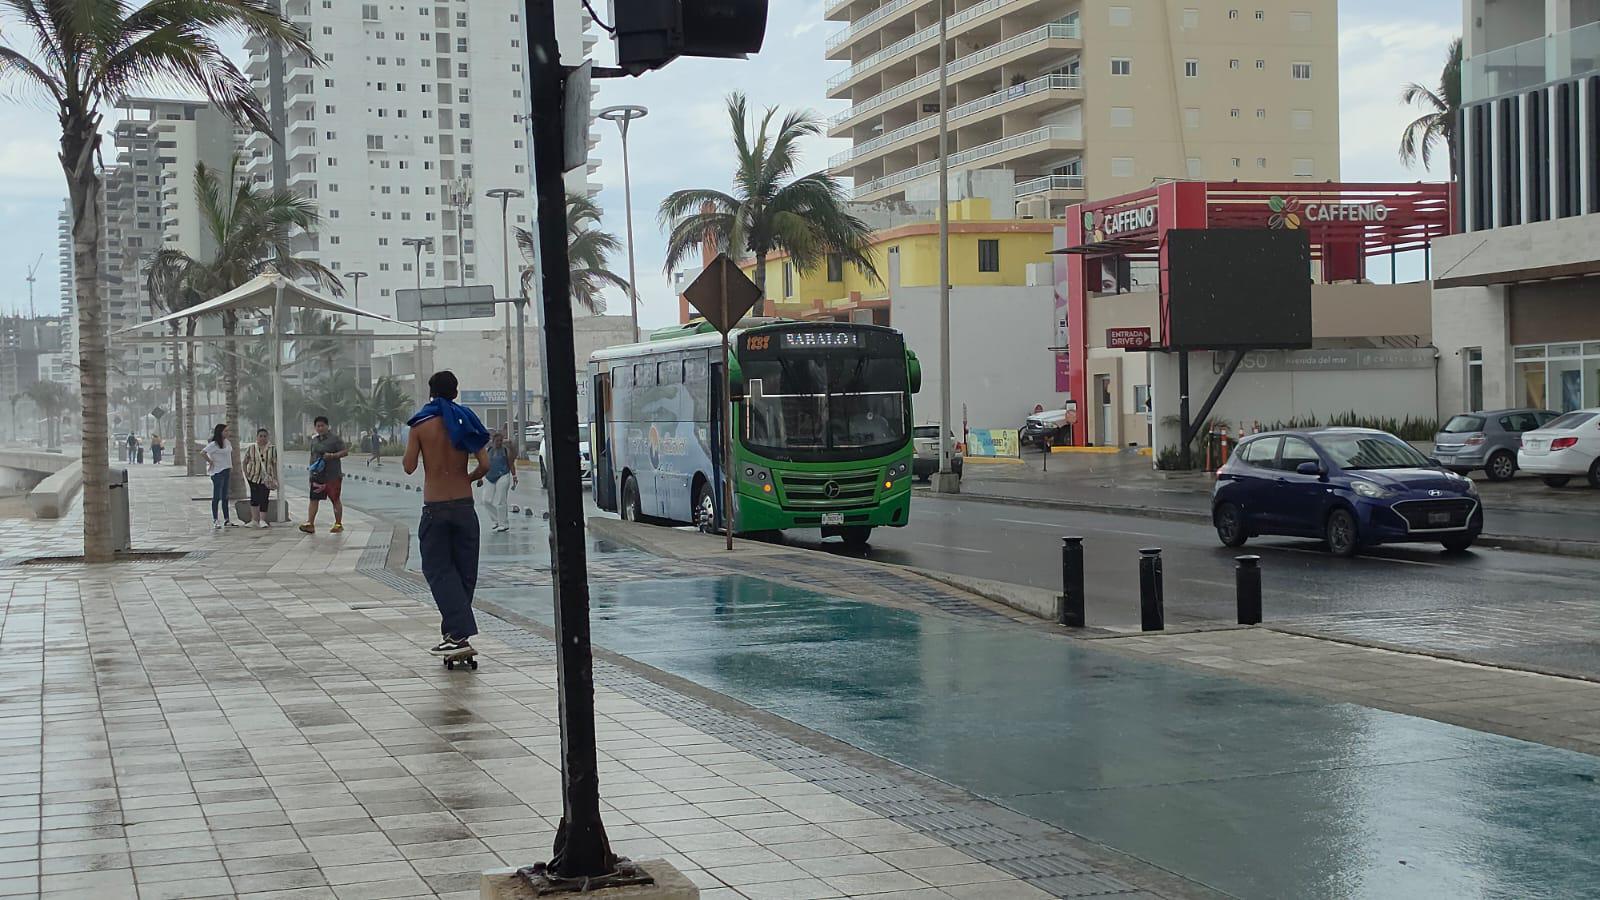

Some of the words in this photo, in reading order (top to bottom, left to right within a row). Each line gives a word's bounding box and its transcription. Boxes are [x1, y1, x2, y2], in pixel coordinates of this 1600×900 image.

[1104, 207, 1154, 234] CAFFENIO
[1305, 204, 1388, 222] CAFFENIO
[1318, 356, 1331, 364] del
